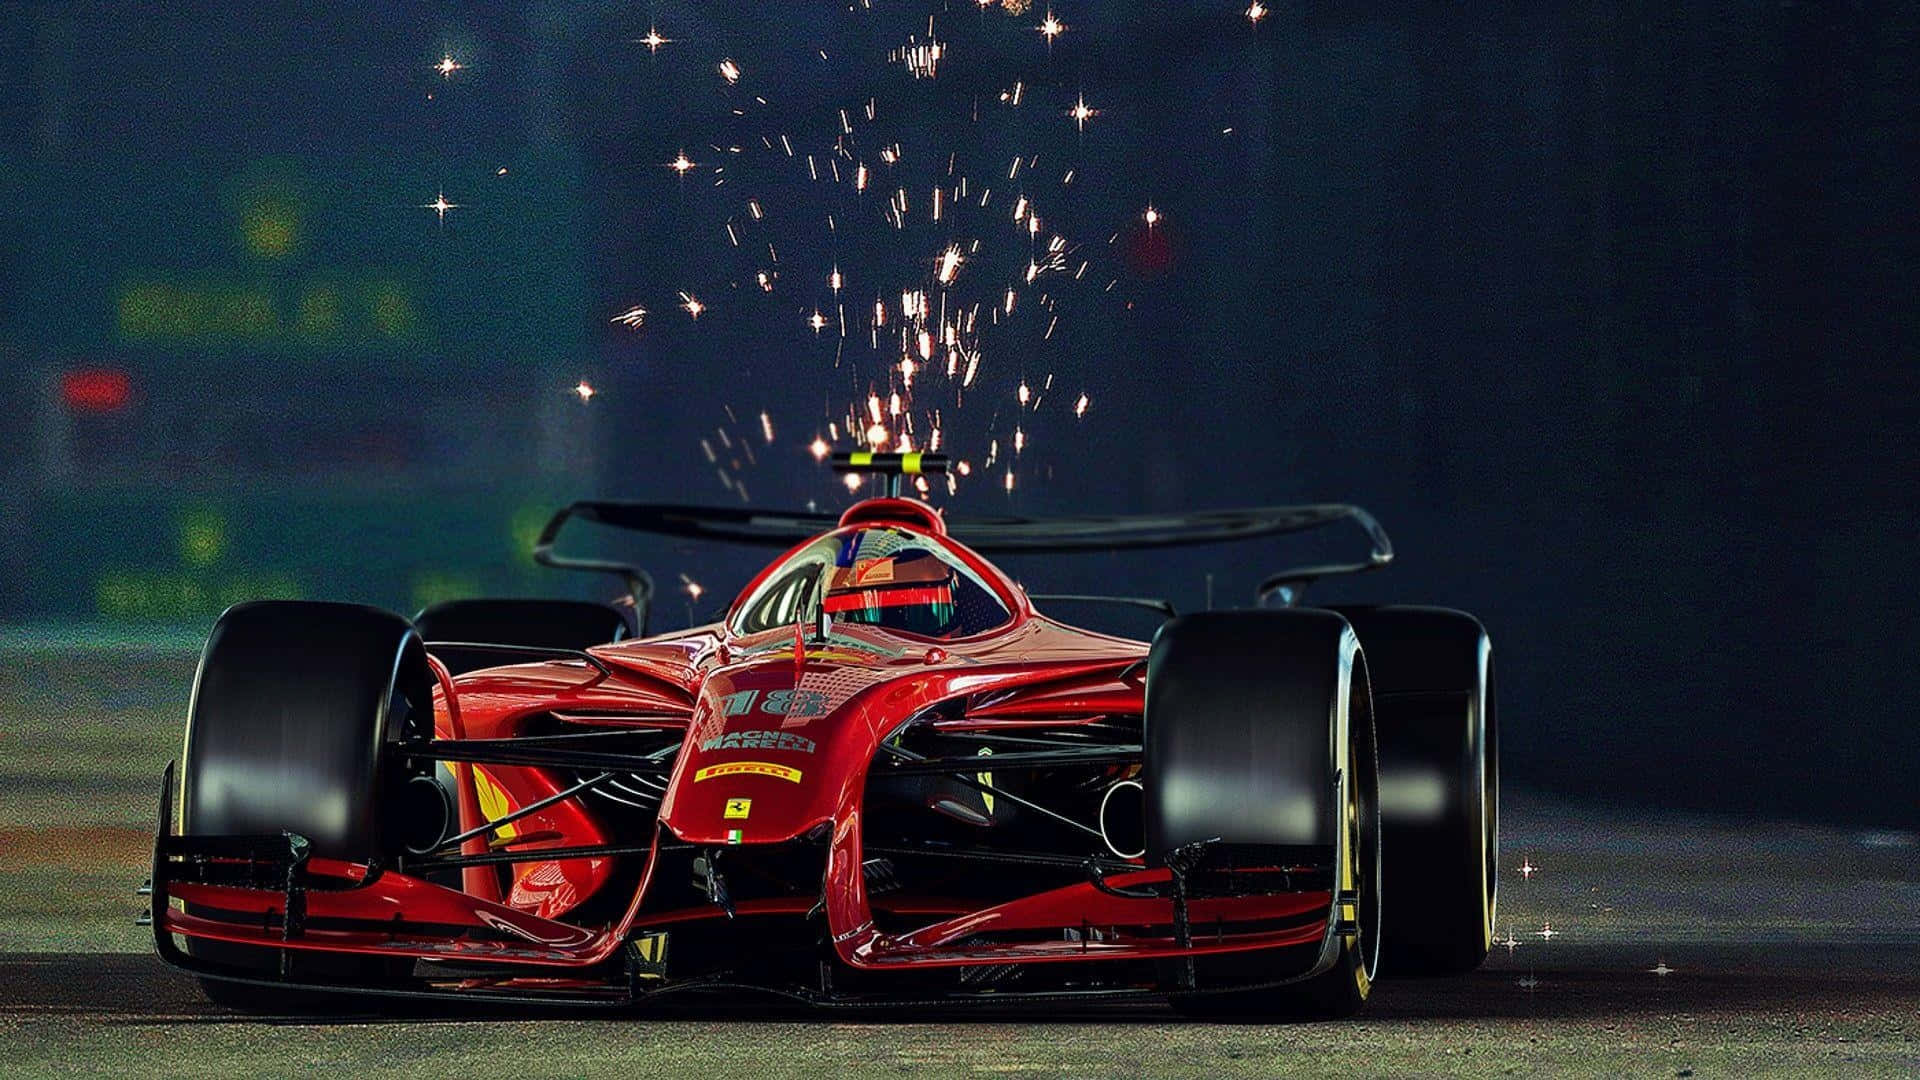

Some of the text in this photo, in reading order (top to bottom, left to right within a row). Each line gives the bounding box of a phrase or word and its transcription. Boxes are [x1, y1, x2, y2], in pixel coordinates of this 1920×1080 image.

[722, 690, 829, 716] 18
[703, 739, 815, 753] MARELLI
[705, 764, 794, 777] PIRELLI
